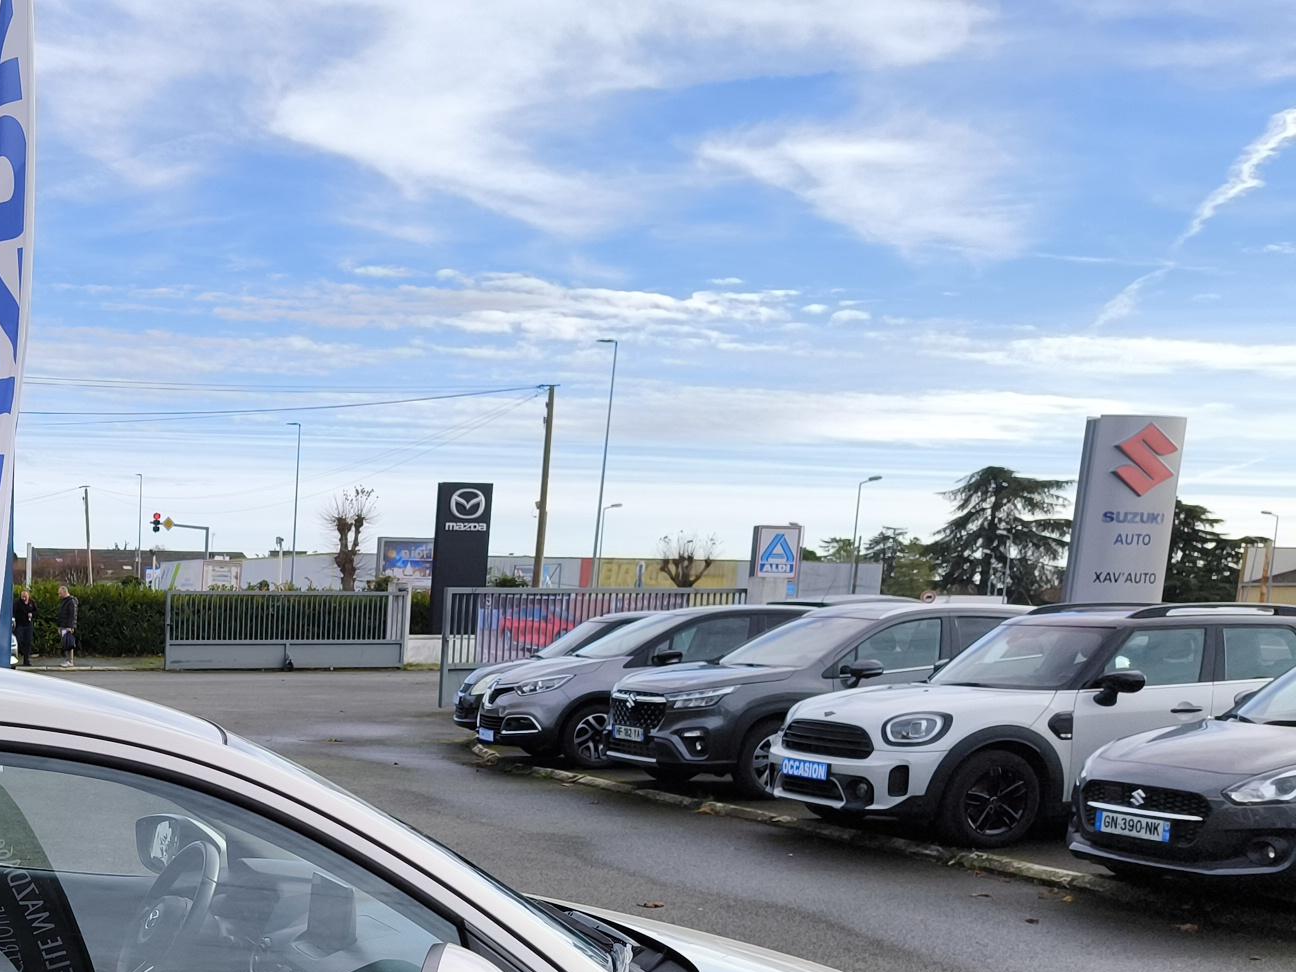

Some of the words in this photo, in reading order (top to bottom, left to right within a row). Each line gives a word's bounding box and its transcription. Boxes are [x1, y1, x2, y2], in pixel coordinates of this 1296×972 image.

[1102, 511, 1165, 524] SUZUKI
[1113, 533, 1152, 546] AUTO
[761, 563, 791, 573] ALDI
[1093, 572, 1157, 584] XAV'AUTO
[782, 758, 828, 780] OCCASION
